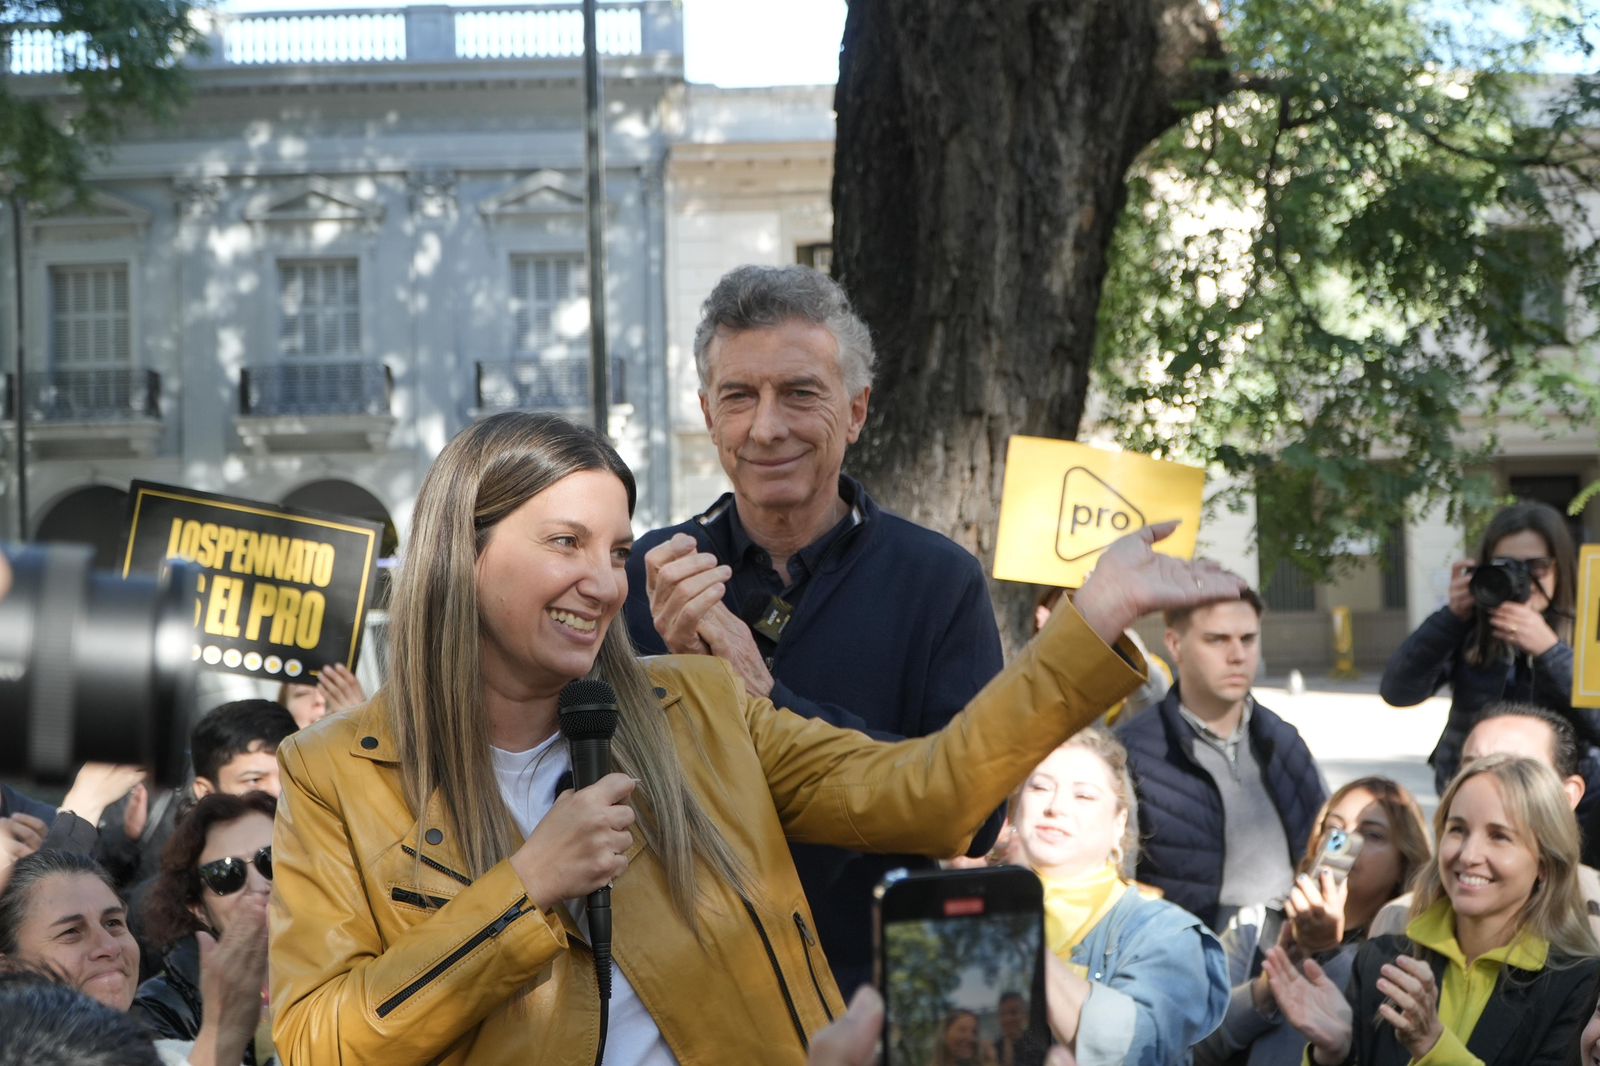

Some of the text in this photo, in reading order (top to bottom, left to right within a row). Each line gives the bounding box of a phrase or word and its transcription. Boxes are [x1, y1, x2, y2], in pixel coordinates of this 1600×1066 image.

[166, 517, 336, 588] LOSPENNATO
[1070, 503, 1130, 535] pro
[204, 574, 245, 638] EL
[245, 582, 326, 650] PRO
